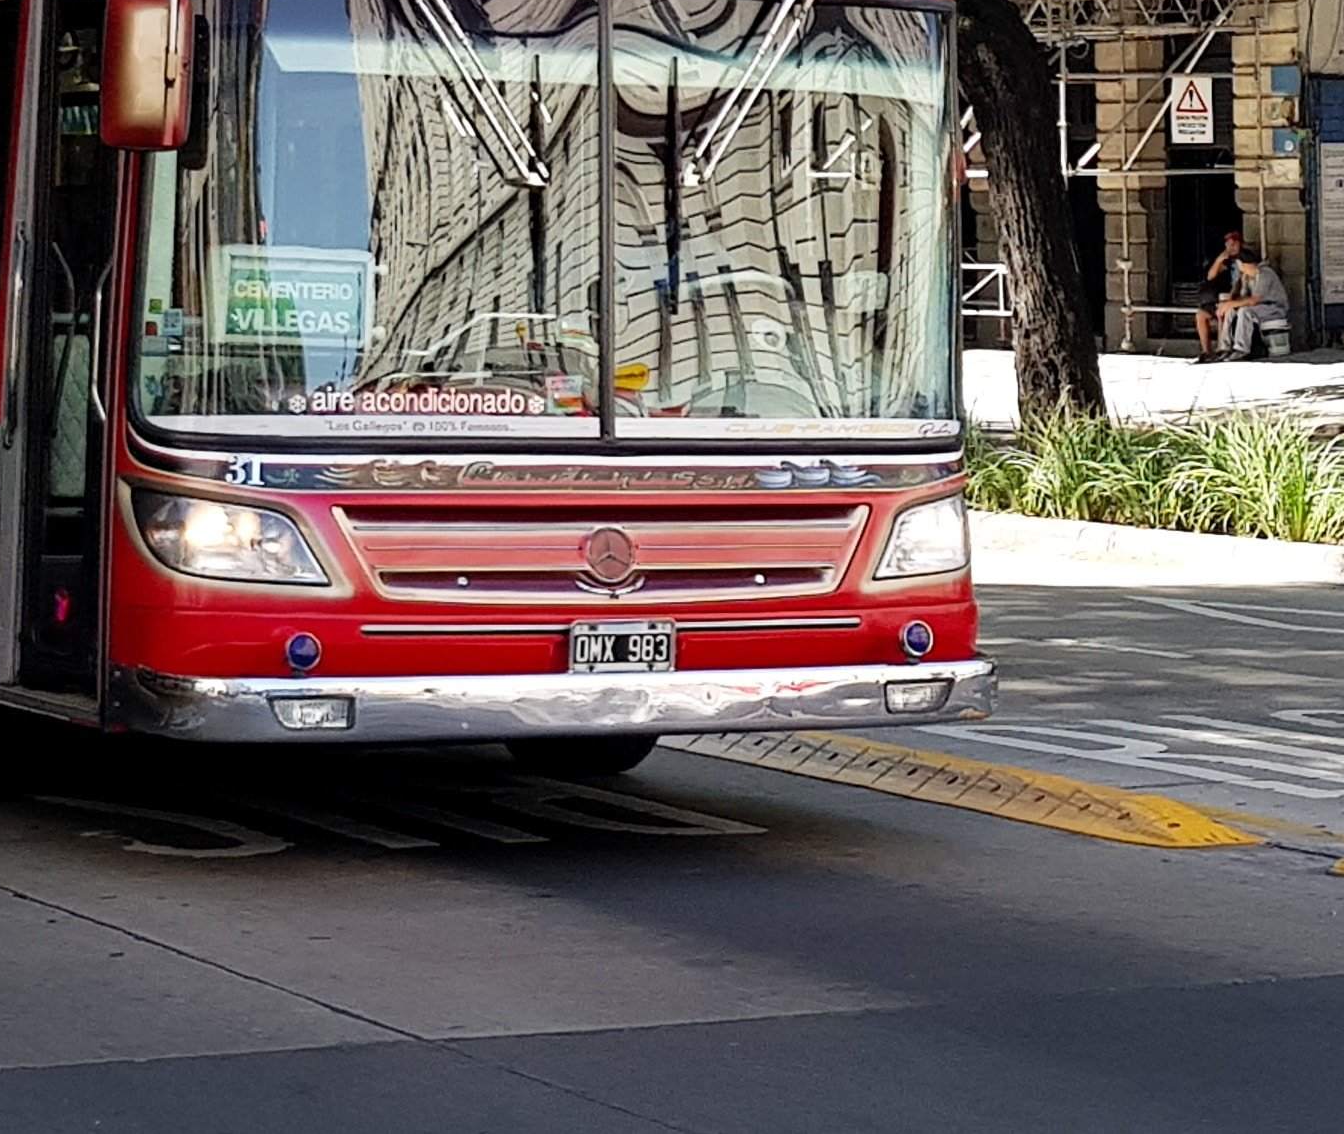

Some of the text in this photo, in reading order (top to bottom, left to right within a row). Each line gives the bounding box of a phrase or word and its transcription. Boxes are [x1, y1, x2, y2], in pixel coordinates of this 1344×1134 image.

[234, 279, 353, 300] CEMENTERIO
[234, 307, 351, 334] VILLEGAS
[312, 384, 525, 413] aire acondicionado
[225, 454, 265, 486] 31
[628, 634, 668, 661] 983
